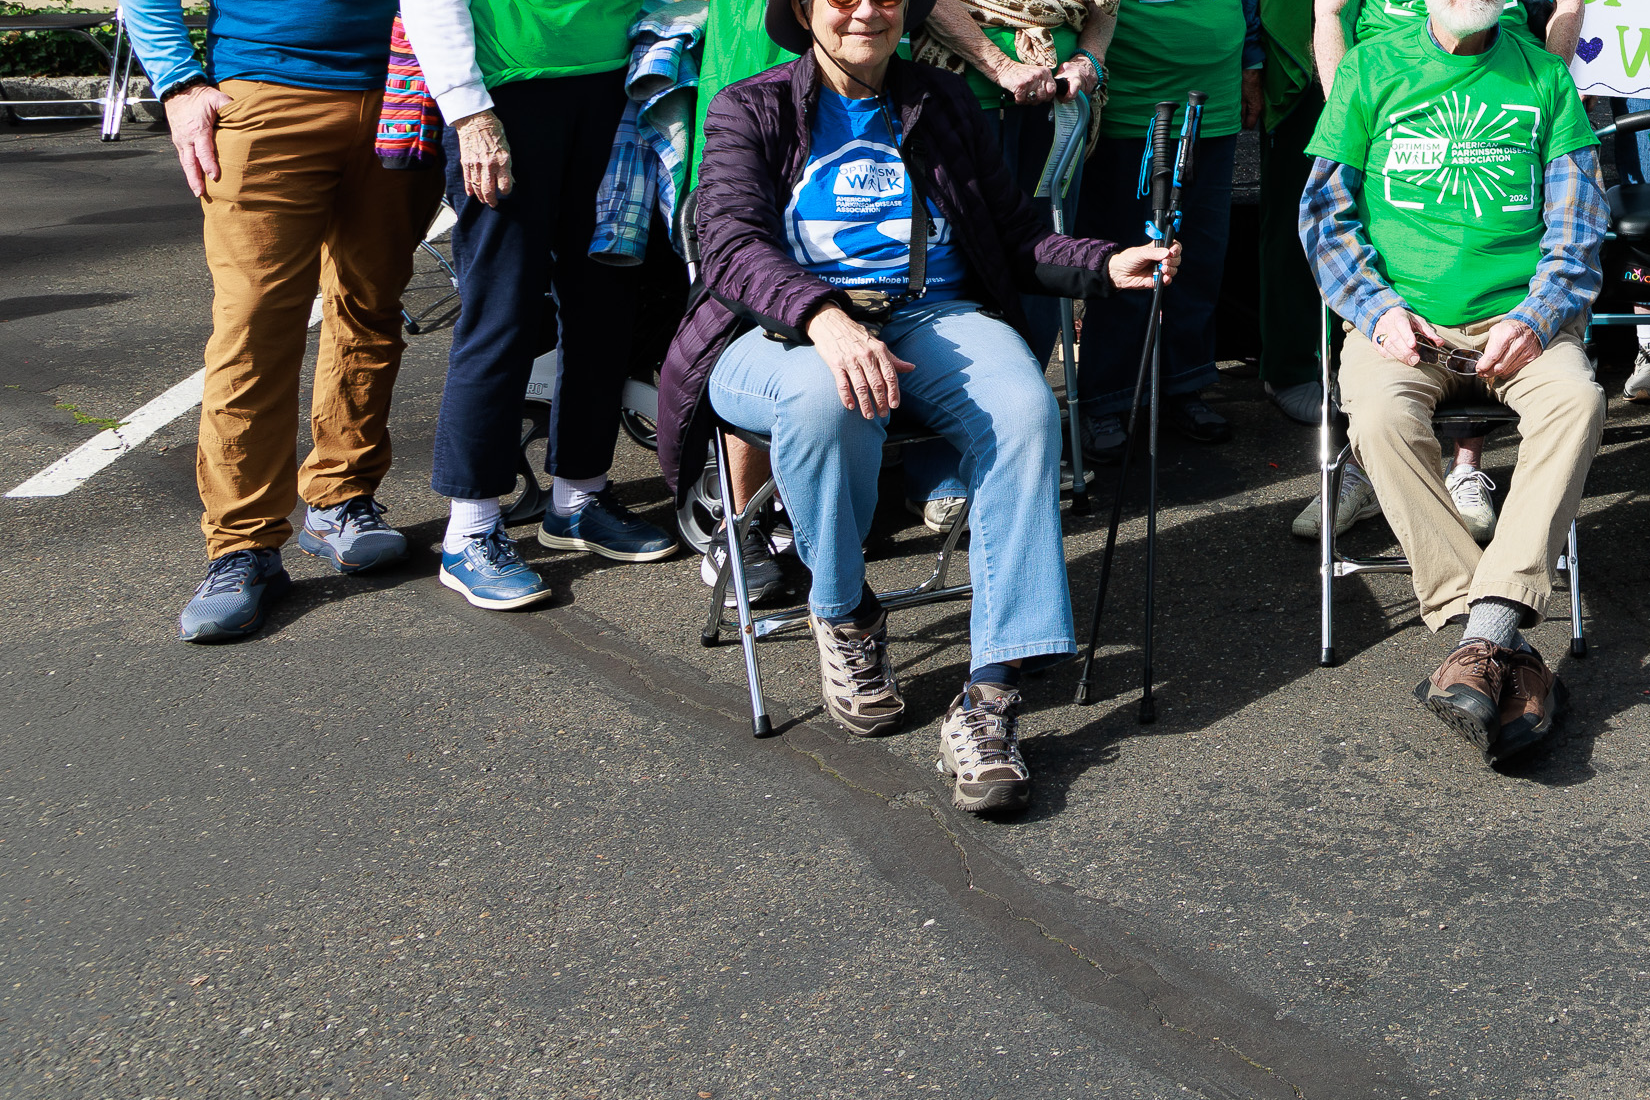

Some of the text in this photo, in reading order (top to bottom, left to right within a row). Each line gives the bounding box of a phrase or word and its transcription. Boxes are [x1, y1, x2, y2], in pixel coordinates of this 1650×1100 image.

[1392, 143, 1440, 151] OPTIMISM
[1451, 148, 1503, 157] PARKINSON
[1451, 154, 1511, 164] ASSOCIATION
[839, 164, 896, 177] OPTIMISM
[1509, 194, 1528, 202] 2024
[875, 200, 903, 208] DISEASE
[829, 276, 877, 285] optimism.
[878, 276, 902, 285] Hope
